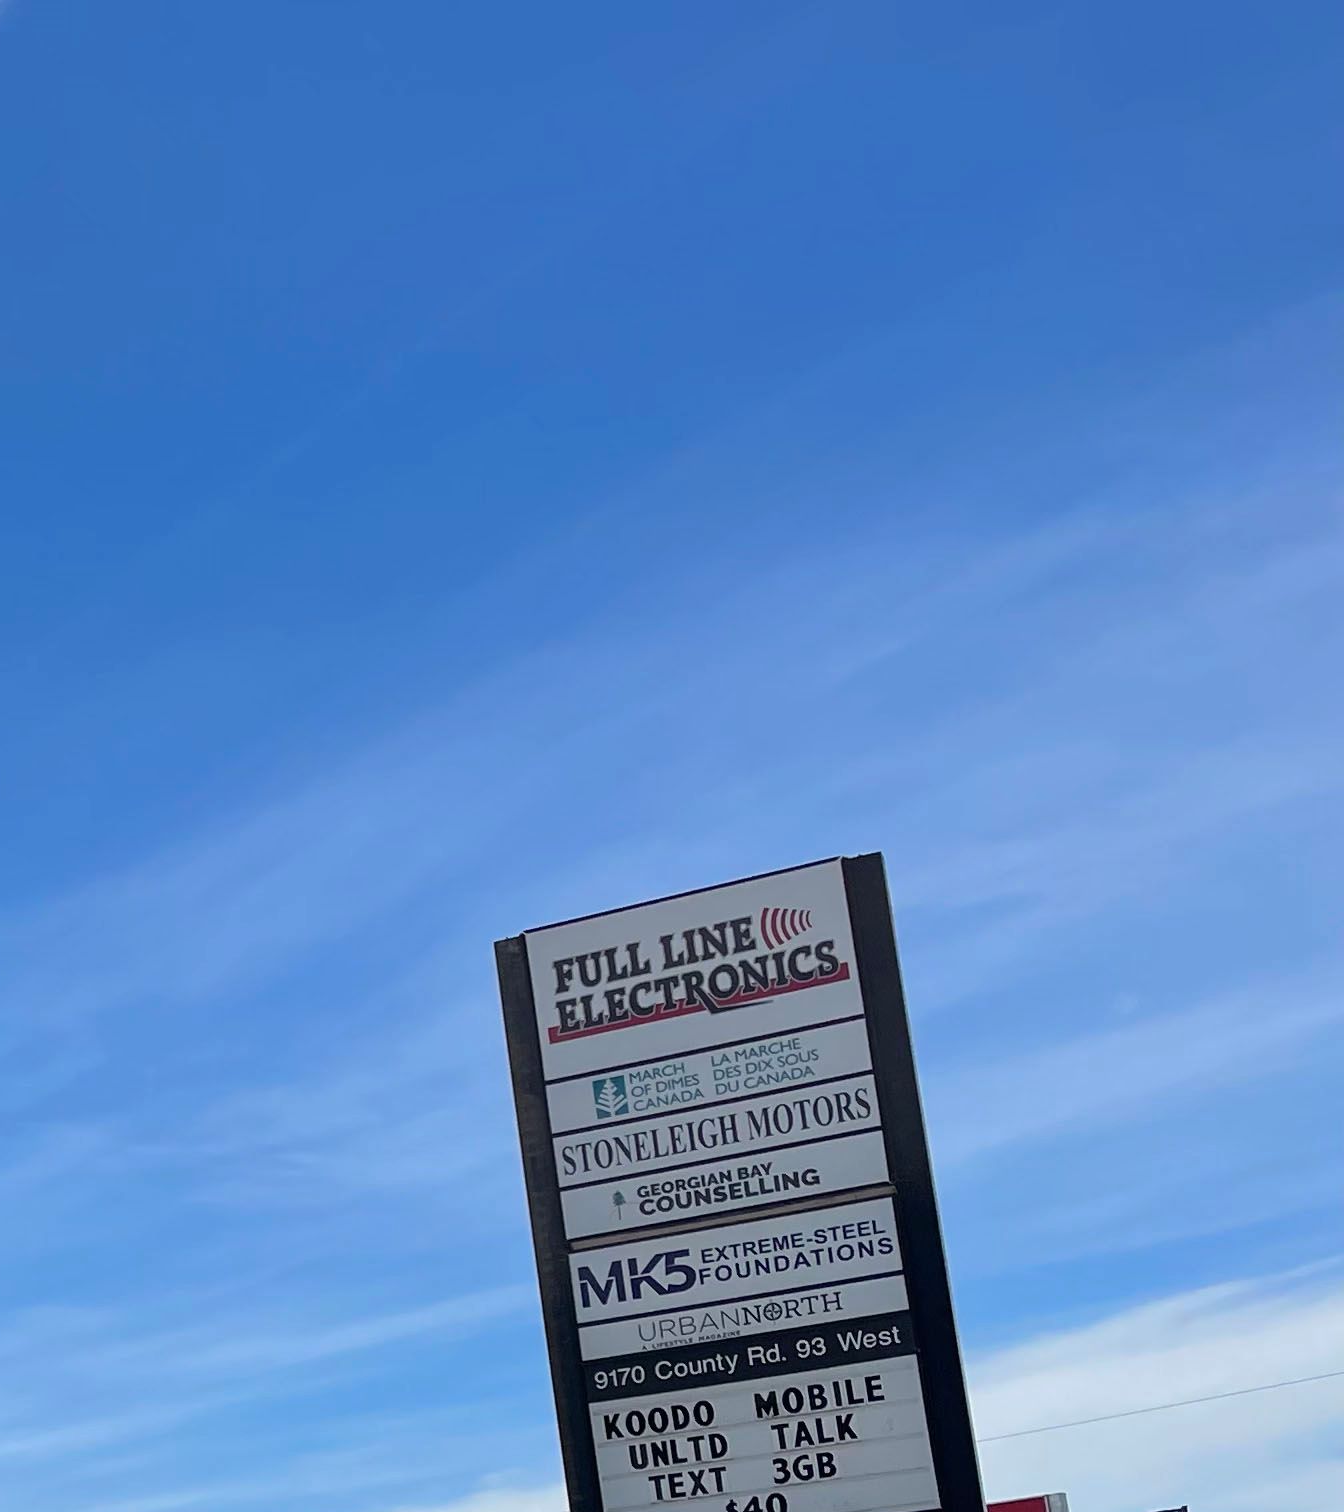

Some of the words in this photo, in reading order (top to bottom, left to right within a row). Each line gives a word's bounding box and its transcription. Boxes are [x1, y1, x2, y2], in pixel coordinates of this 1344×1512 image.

[552, 941, 652, 994] FULL
[659, 916, 756, 968] LINE
[555, 940, 840, 1034] ELECTRONICS
[629, 1062, 686, 1083] MARCH
[711, 1052, 733, 1067] LA
[734, 1038, 802, 1062] MARCHE
[713, 1063, 742, 1081] DES
[745, 1058, 775, 1074] DIX
[776, 1049, 819, 1069] SOUS
[631, 1081, 654, 1098] OF
[656, 1074, 700, 1093] DIMES
[633, 1090, 704, 1112] CANADA
[715, 1080, 740, 1096] DU
[742, 1067, 816, 1090] CANADA
[561, 1112, 741, 1176] STONELEIGH
[746, 1088, 872, 1140] MOTORS
[636, 1170, 733, 1199] GEORGIAN
[737, 1162, 773, 1180] BAY
[638, 1168, 821, 1216] COUNSELLING
[698, 1237, 894, 1285] FOUNDATIONS
[700, 1220, 887, 1264] EXTREME-STEEL
[577, 1248, 697, 1308] MK5
[594, 1366, 646, 1389] 9170
[654, 1355, 738, 1380] County
[748, 1346, 787, 1367] Rd.
[796, 1338, 827, 1358] 93
[838, 1325, 901, 1352] West
[603, 1400, 715, 1440] KOODO
[753, 1375, 885, 1419] MOBILE
[628, 1433, 728, 1470] UNLTD
[770, 1414, 858, 1450] TALK
[648, 1467, 727, 1500] TEXT
[772, 1452, 838, 1485] 3GB
